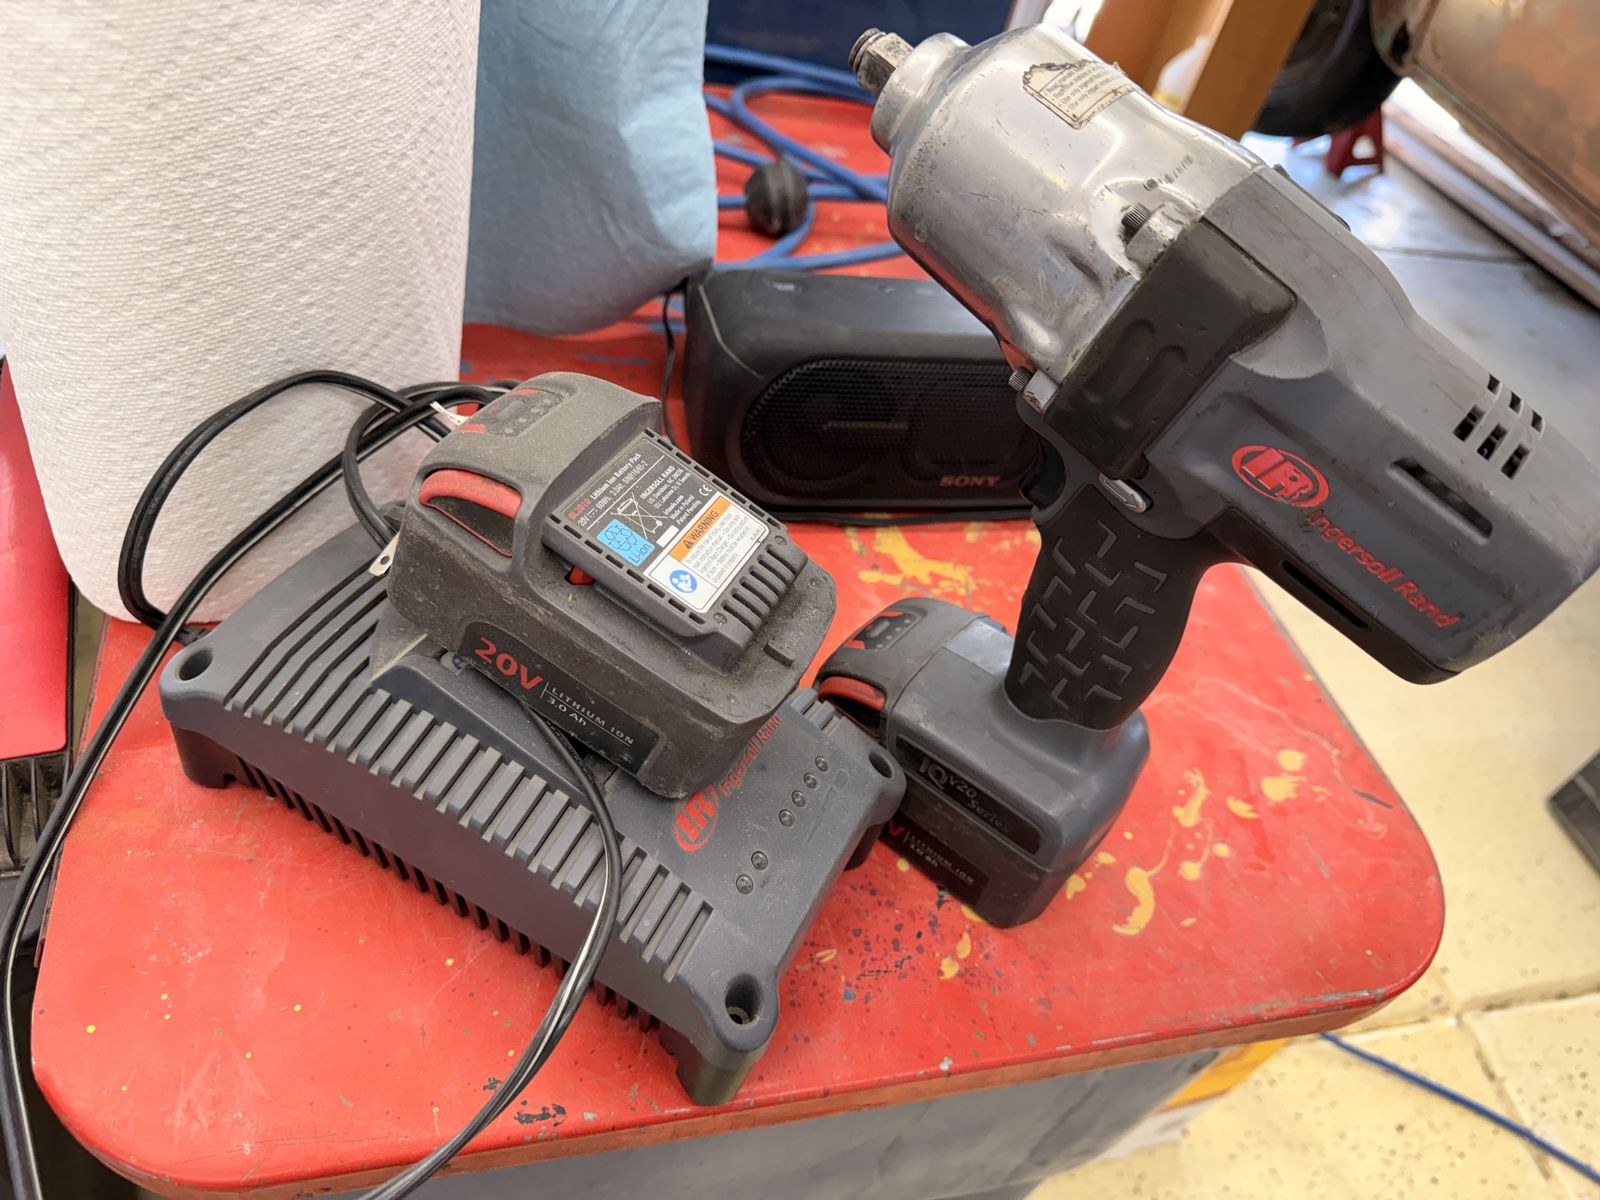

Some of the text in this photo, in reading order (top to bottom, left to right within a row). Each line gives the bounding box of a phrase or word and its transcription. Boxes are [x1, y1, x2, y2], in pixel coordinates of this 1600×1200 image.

[590, 482, 609, 499] Lithium
[607, 475, 616, 484] Ion
[614, 461, 632, 477] Battery
[630, 453, 641, 463] Pack
[639, 465, 675, 499] INGERSOLL RAND
[938, 475, 1001, 488] SONY
[669, 507, 681, 519] Made
[691, 511, 719, 540] WARNING
[1307, 509, 1404, 584] Ingersoll
[1393, 580, 1461, 628] Rand
[474, 637, 543, 689] 20V
[547, 697, 587, 726] 3.0 Ah
[551, 687, 606, 726] LITHIUM
[610, 727, 634, 745] ION
[717, 739, 761, 796] Ingersoll
